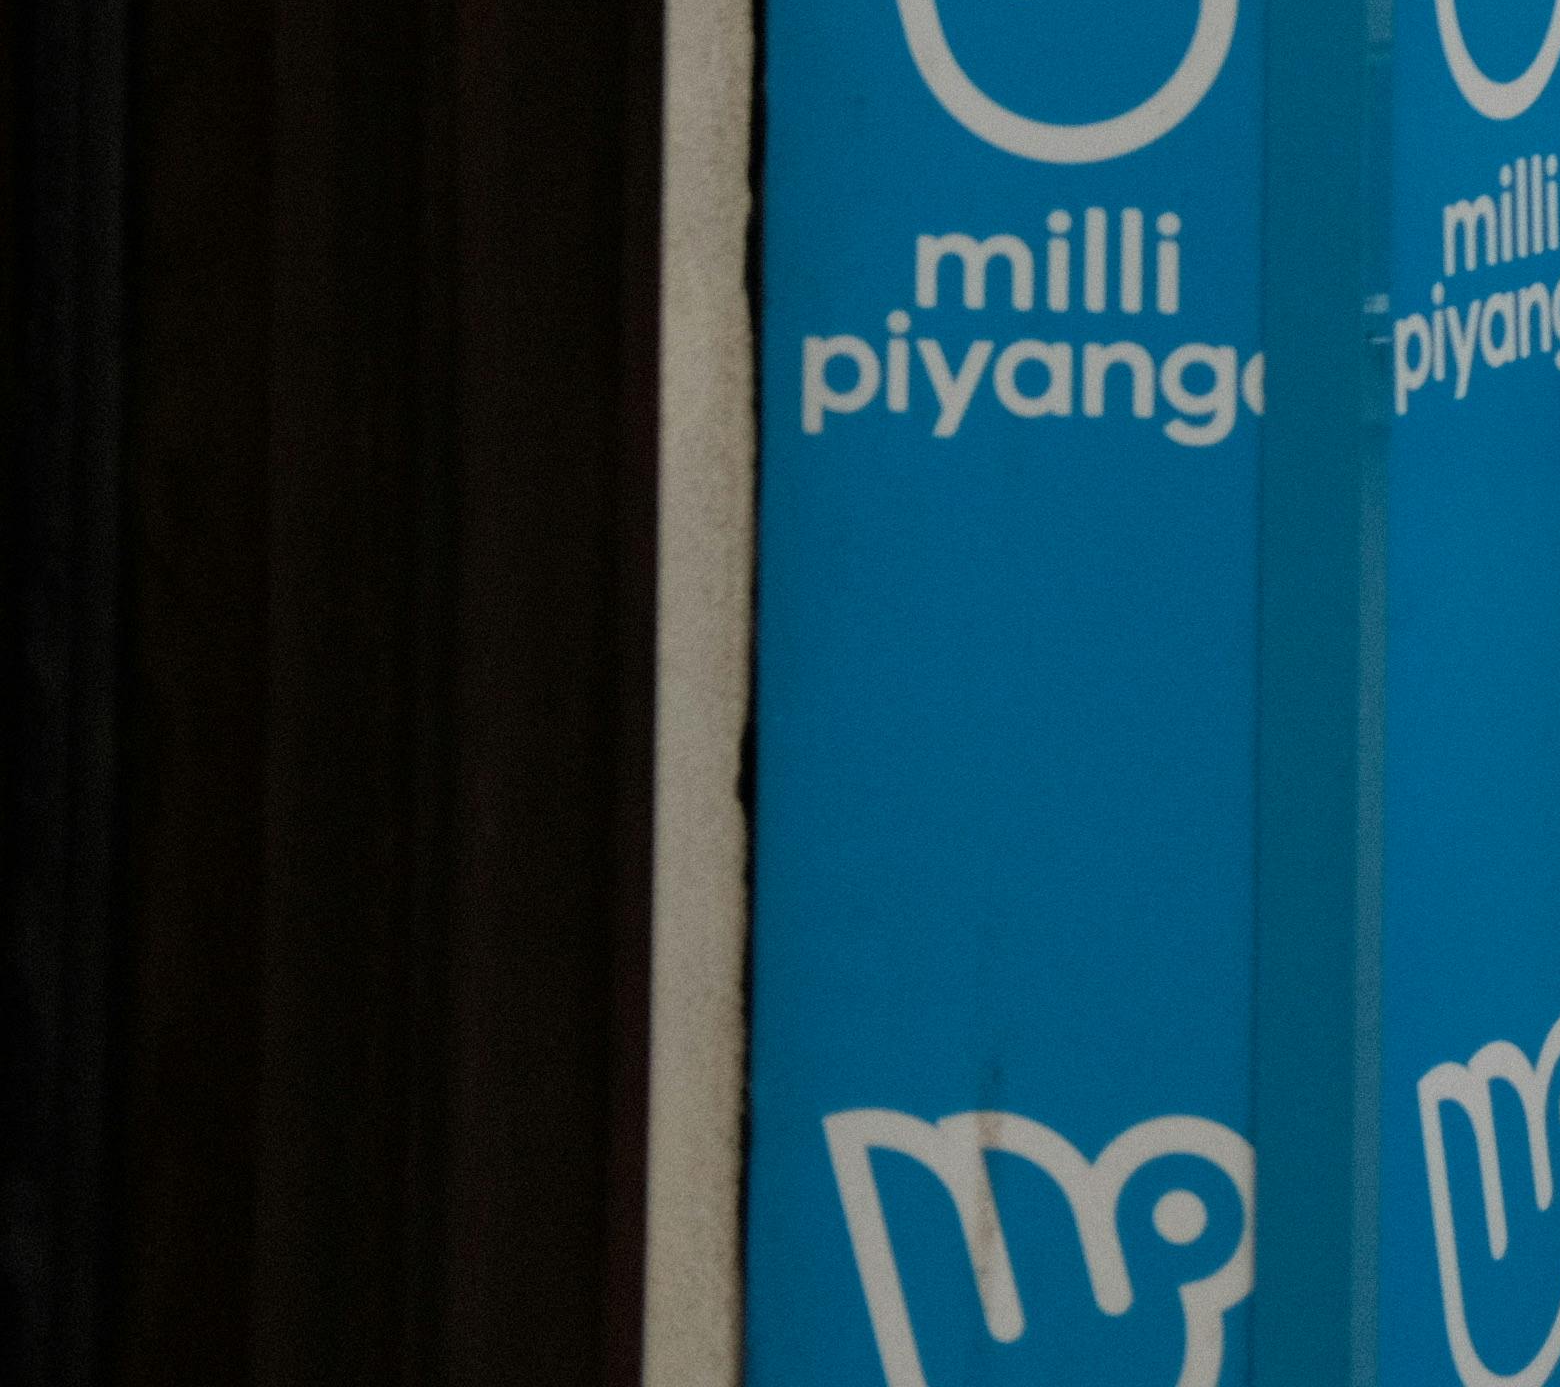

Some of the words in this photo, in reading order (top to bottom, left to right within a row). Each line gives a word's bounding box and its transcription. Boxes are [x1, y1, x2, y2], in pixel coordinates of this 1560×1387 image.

[915, 206, 1181, 315] milli
[1443, 154, 1560, 277] milli
[802, 310, 1265, 447] piyang
